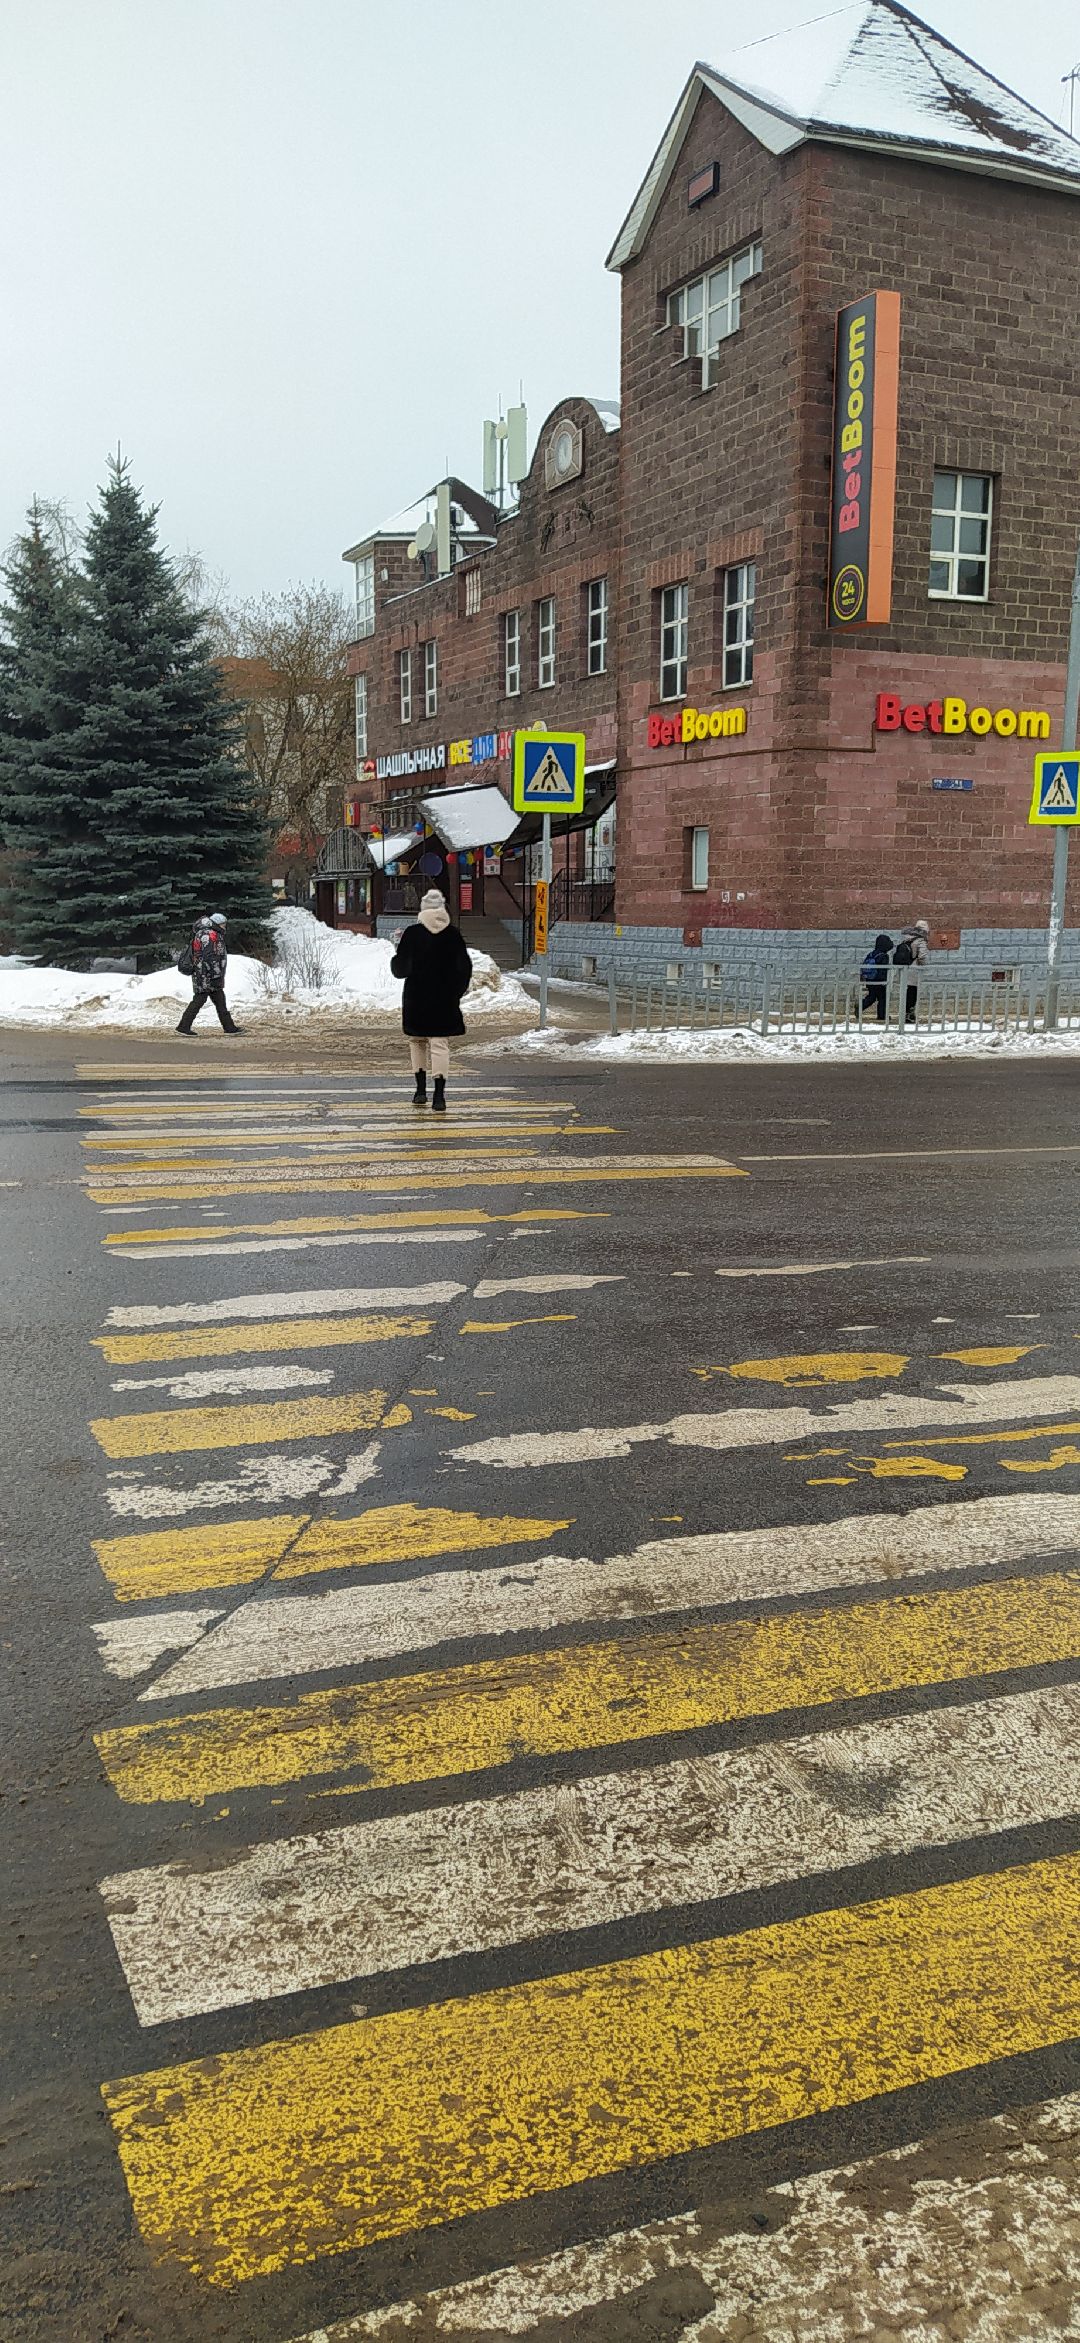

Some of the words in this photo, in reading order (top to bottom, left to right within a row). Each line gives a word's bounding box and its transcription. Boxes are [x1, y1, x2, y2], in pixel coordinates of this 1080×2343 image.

[839, 314, 866, 533] BetBoom
[842, 580, 855, 597] 24
[648, 707, 747, 748] BetBoom
[876, 692, 1051, 739] BetBoom
[376, 744, 446, 779] ШАШЛЫЧНАЯ
[450, 739, 472, 765] ВСЕ
[472, 734, 497, 765] ДЛЯ
